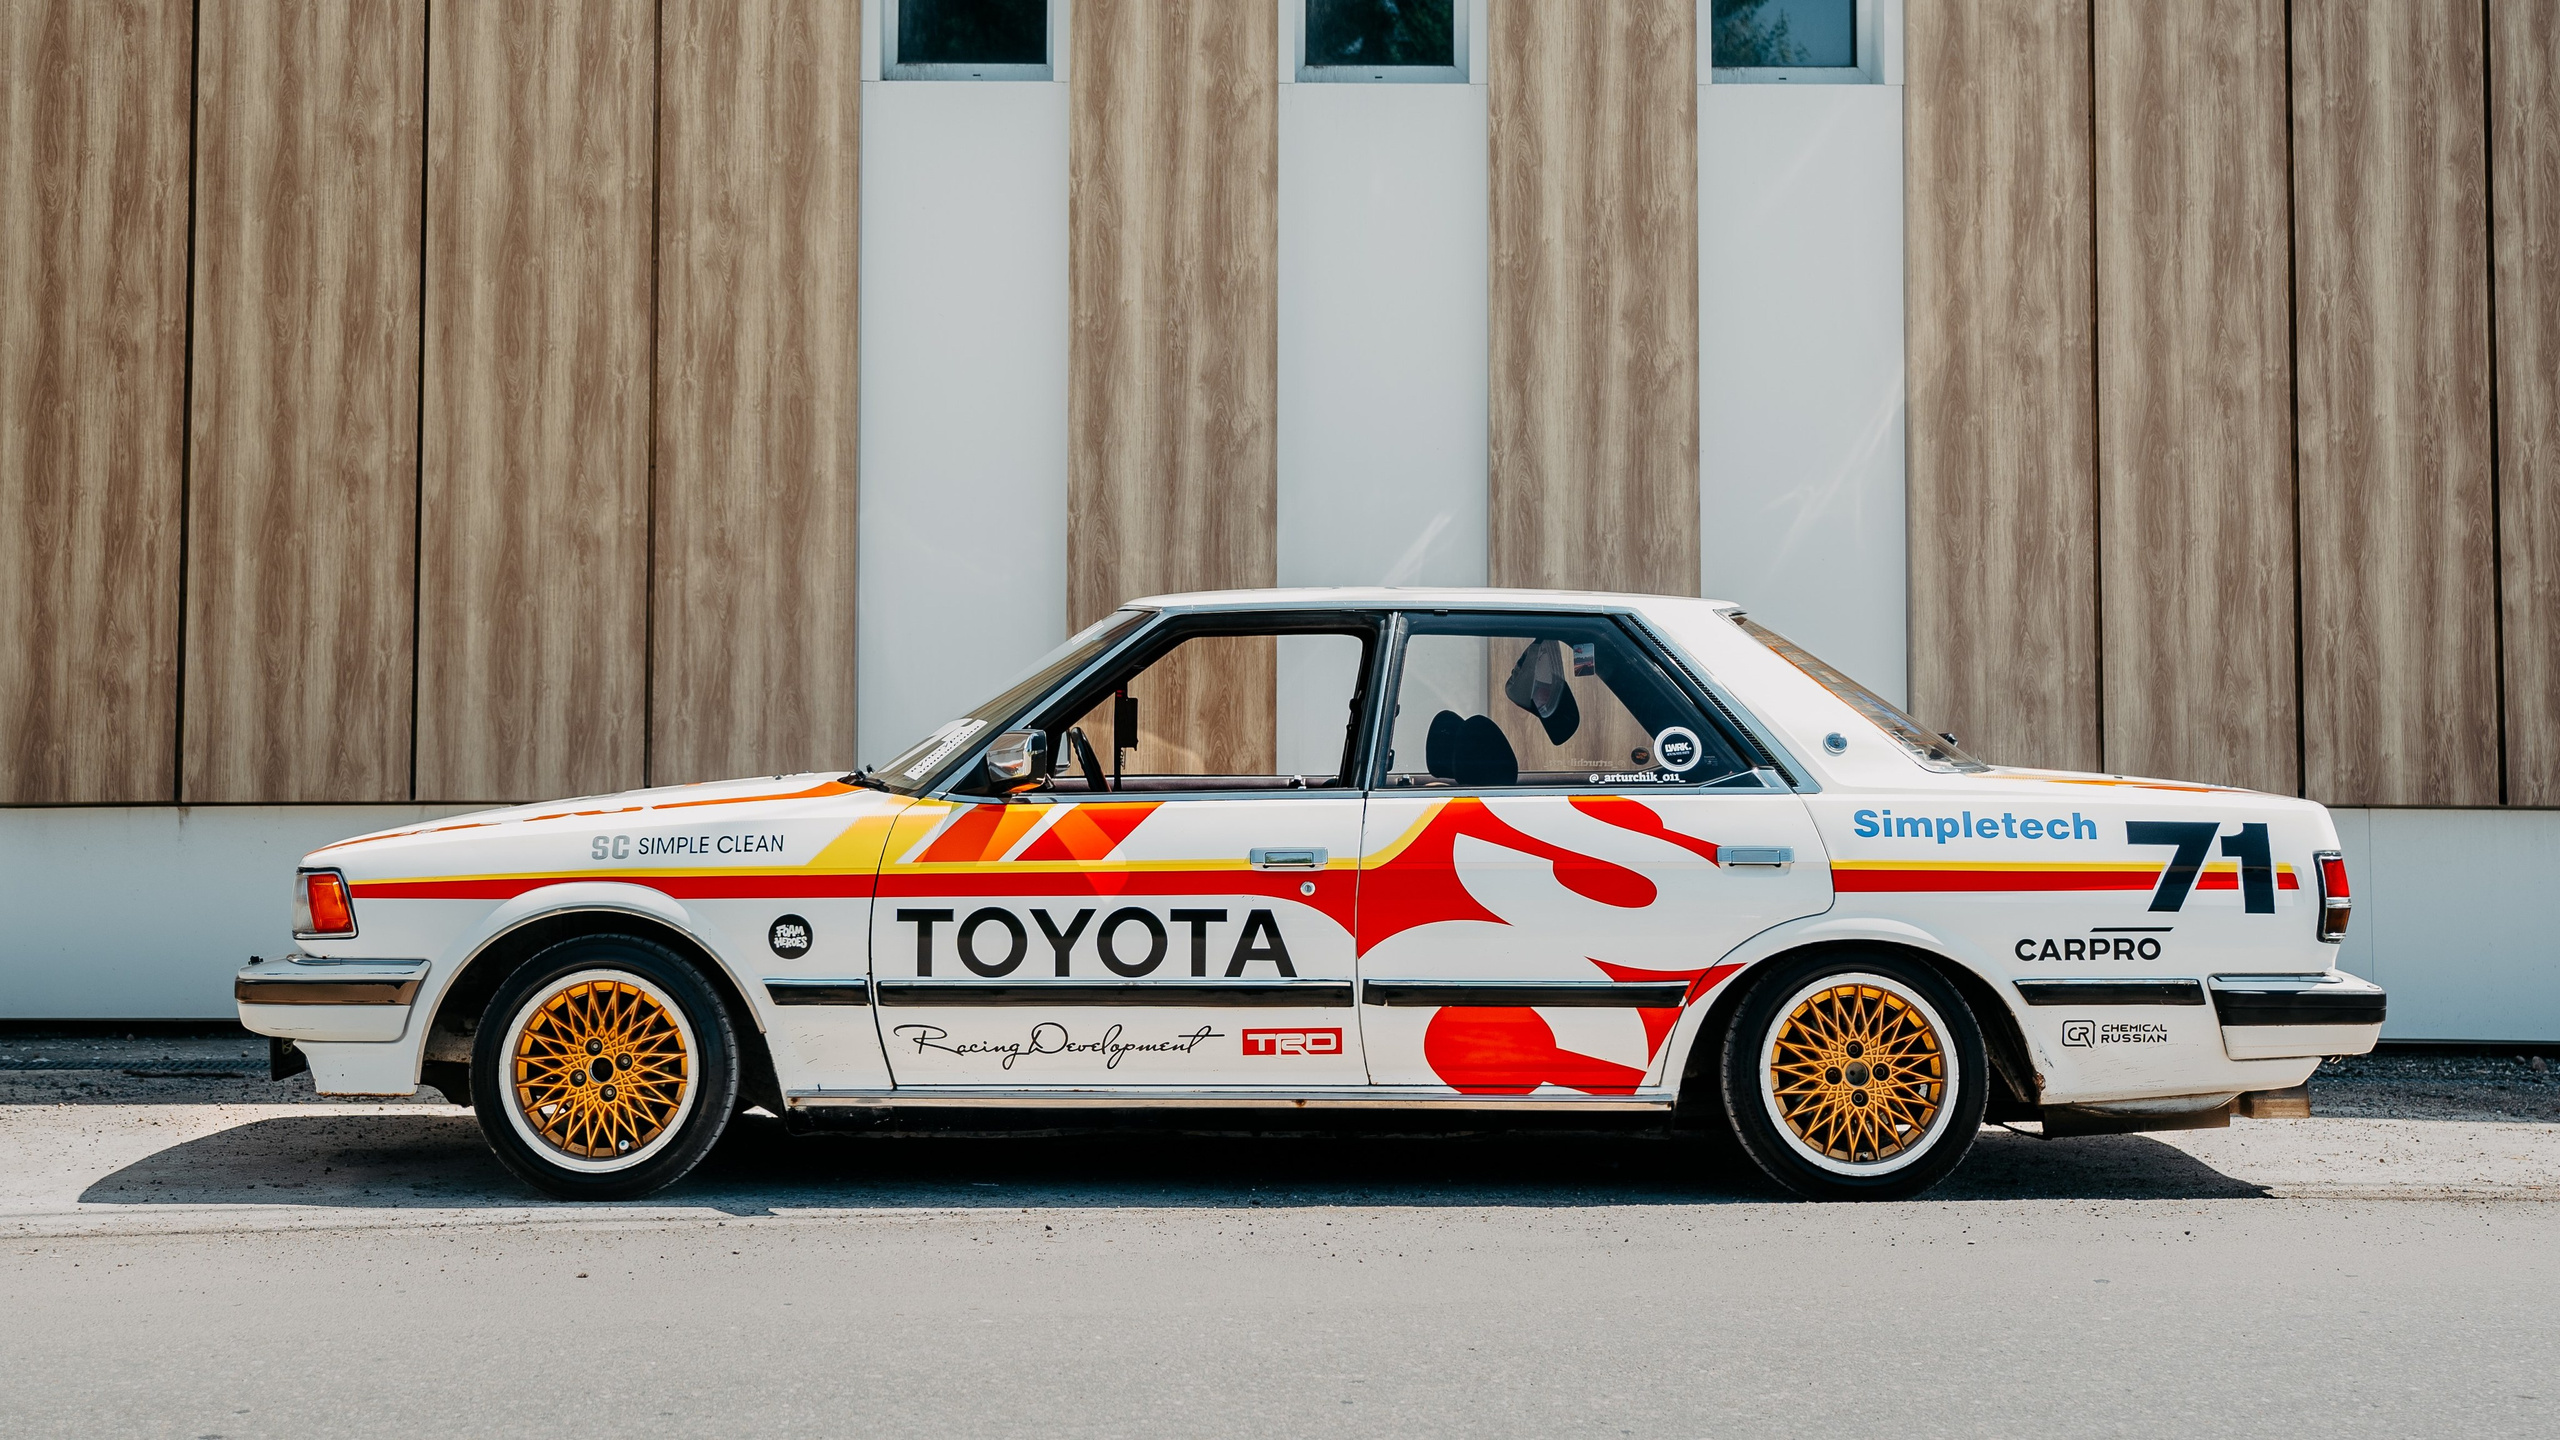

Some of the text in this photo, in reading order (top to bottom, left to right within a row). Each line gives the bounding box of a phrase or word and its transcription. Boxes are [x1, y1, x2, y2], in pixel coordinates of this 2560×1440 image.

[1589, 772, 1686, 784] @_arturchik_011_
[1853, 809, 2098, 845] Simpletech
[591, 834, 784, 860] SC SIMPLE CLEAN
[2125, 820, 2276, 914] 71
[774, 936, 808, 949] HEROES
[775, 924, 806, 937] FOAM
[896, 906, 1298, 979] TOYOTA
[2014, 937, 2161, 961] CARPRO
[2101, 1024, 2167, 1032] CHEMICAL
[2101, 1034, 2167, 1043] RUSSIAN
[893, 1022, 1225, 1070] Racing Development
[1246, 1032, 1338, 1056] TRD
